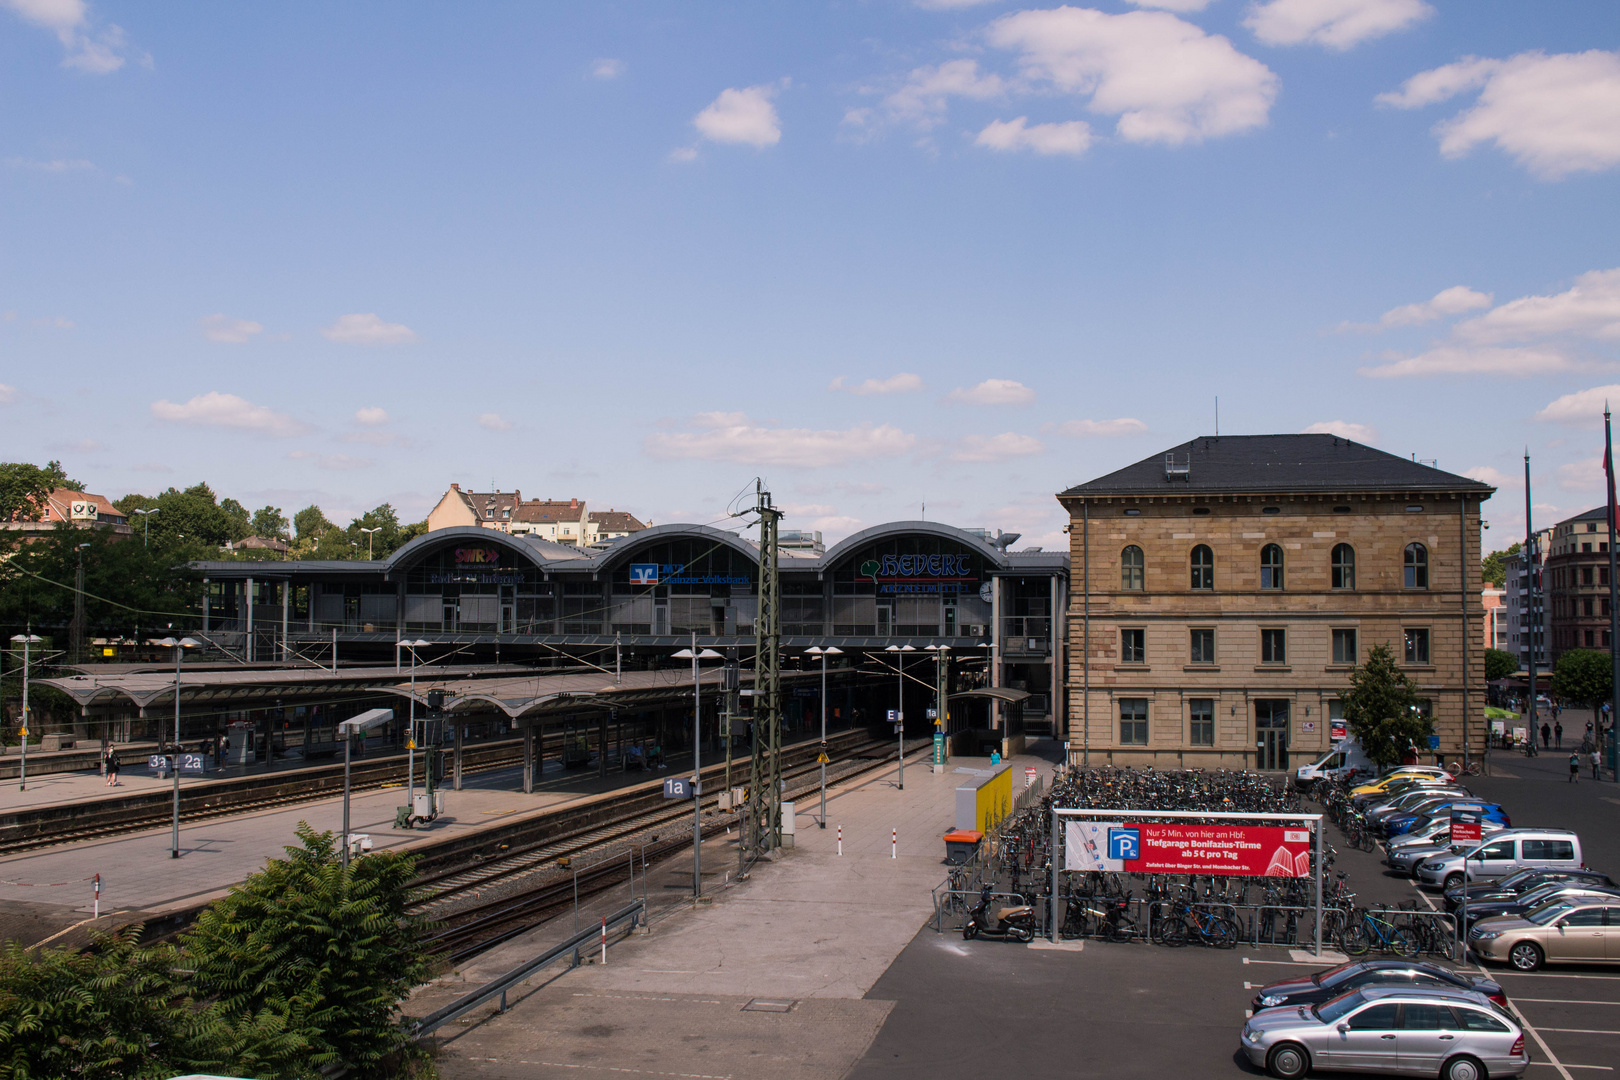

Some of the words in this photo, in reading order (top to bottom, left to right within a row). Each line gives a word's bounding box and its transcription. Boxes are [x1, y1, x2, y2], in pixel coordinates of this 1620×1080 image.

[455, 548, 486, 563] SWR
[881, 554, 971, 576] HEVERT
[480, 573, 525, 584] Internet
[662, 575, 699, 584] Mainzer
[702, 575, 750, 584] Volksbank
[880, 585, 971, 593] ARZNEIMITTEL
[888, 710, 895, 720] E
[927, 709, 937, 717] 1a
[150, 755, 167, 768] 3a
[184, 754, 202, 769] 2a
[666, 779, 684, 795] 1a
[1146, 829, 1160, 837] Nur
[1200, 830, 1214, 838] hier
[1229, 831, 1246, 839] Hbf:
[1146, 839, 1189, 849] Tiefgarage
[1190, 840, 1262, 849] Bonifazius-Türme
[1206, 851, 1221, 859] pro
[1222, 850, 1238, 860] Tag
